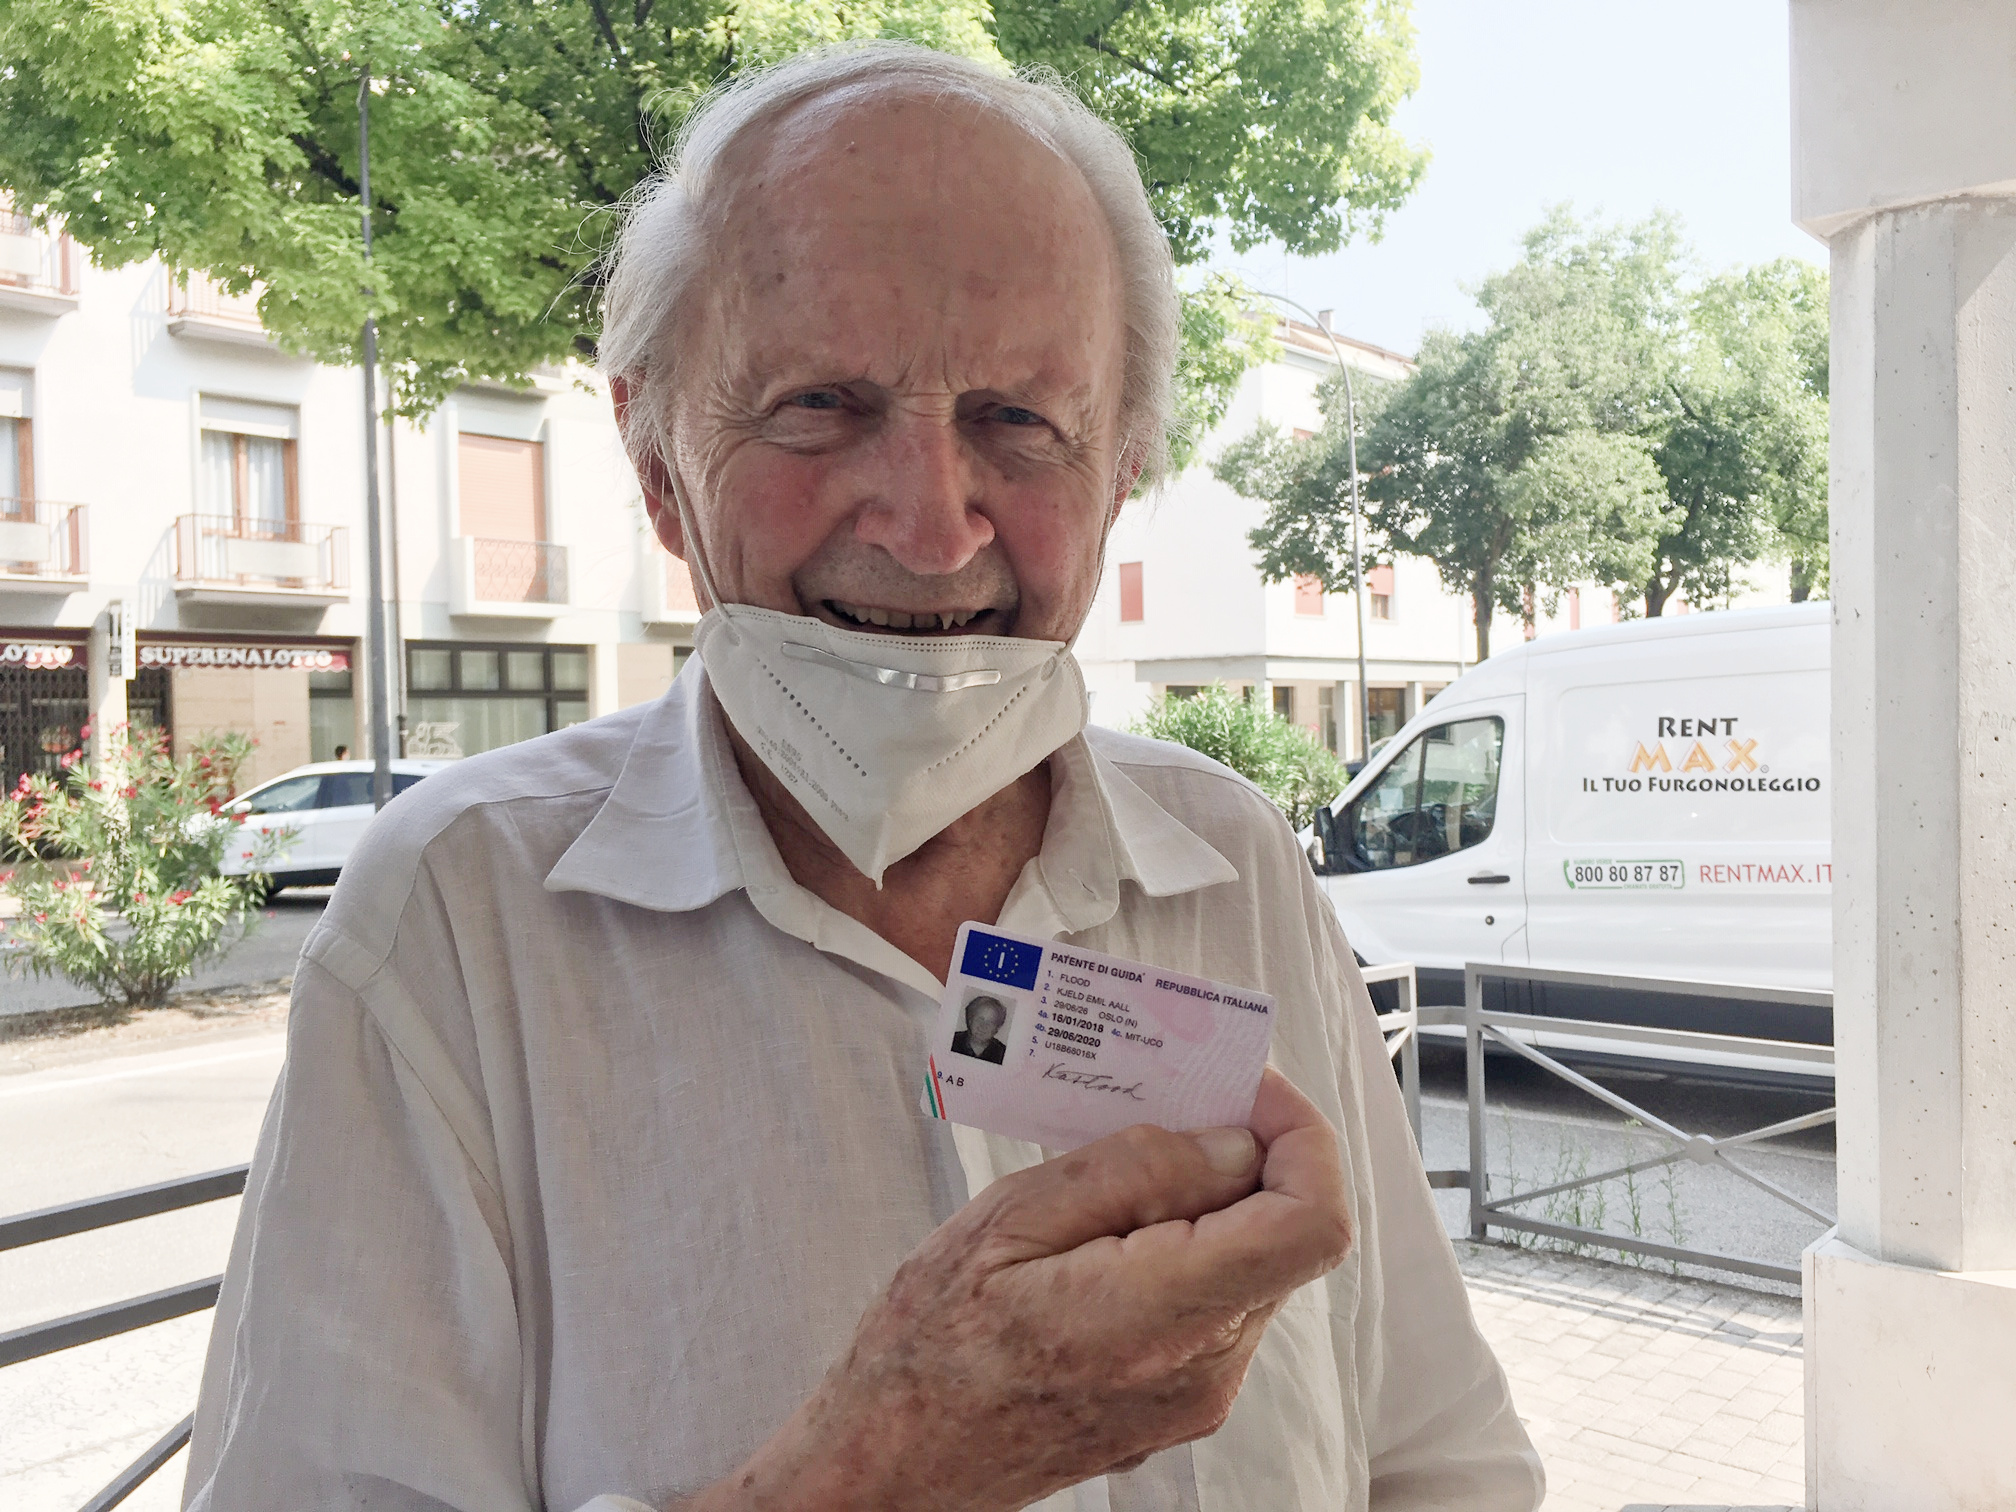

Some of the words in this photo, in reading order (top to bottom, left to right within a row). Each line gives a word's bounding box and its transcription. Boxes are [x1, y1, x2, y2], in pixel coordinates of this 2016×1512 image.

[140, 647, 333, 667] SUPERENALOTTO
[1658, 716, 1739, 738] RENT
[1603, 777, 1642, 792] TUO
[1649, 777, 1821, 792] FURGONOLEGGIO
[1575, 866, 1603, 882] 800
[1609, 866, 1628, 882] 80
[1634, 866, 1653, 882] 87
[1659, 865, 1679, 882] 87
[1700, 864, 1832, 883] RENTMAX.IT
[1051, 952, 1096, 971] PATENTE
[1097, 964, 1109, 974] DI
[1155, 978, 1220, 1003] REPUBBLICA
[1222, 995, 1268, 1014] ITALIANA
[1060, 973, 1091, 987] FLOOD
[1056, 987, 1085, 1001] KJELD
[1086, 994, 1107, 1006] EMIL
[1108, 1000, 1130, 1012] AALL
[1052, 1012, 1104, 1033] 16/01/2018
[1098, 1011, 1124, 1024] OSLO
[1047, 1026, 1101, 1048] 29/06/2020
[946, 1075, 954, 1084] A
[957, 1078, 964, 1087] B
